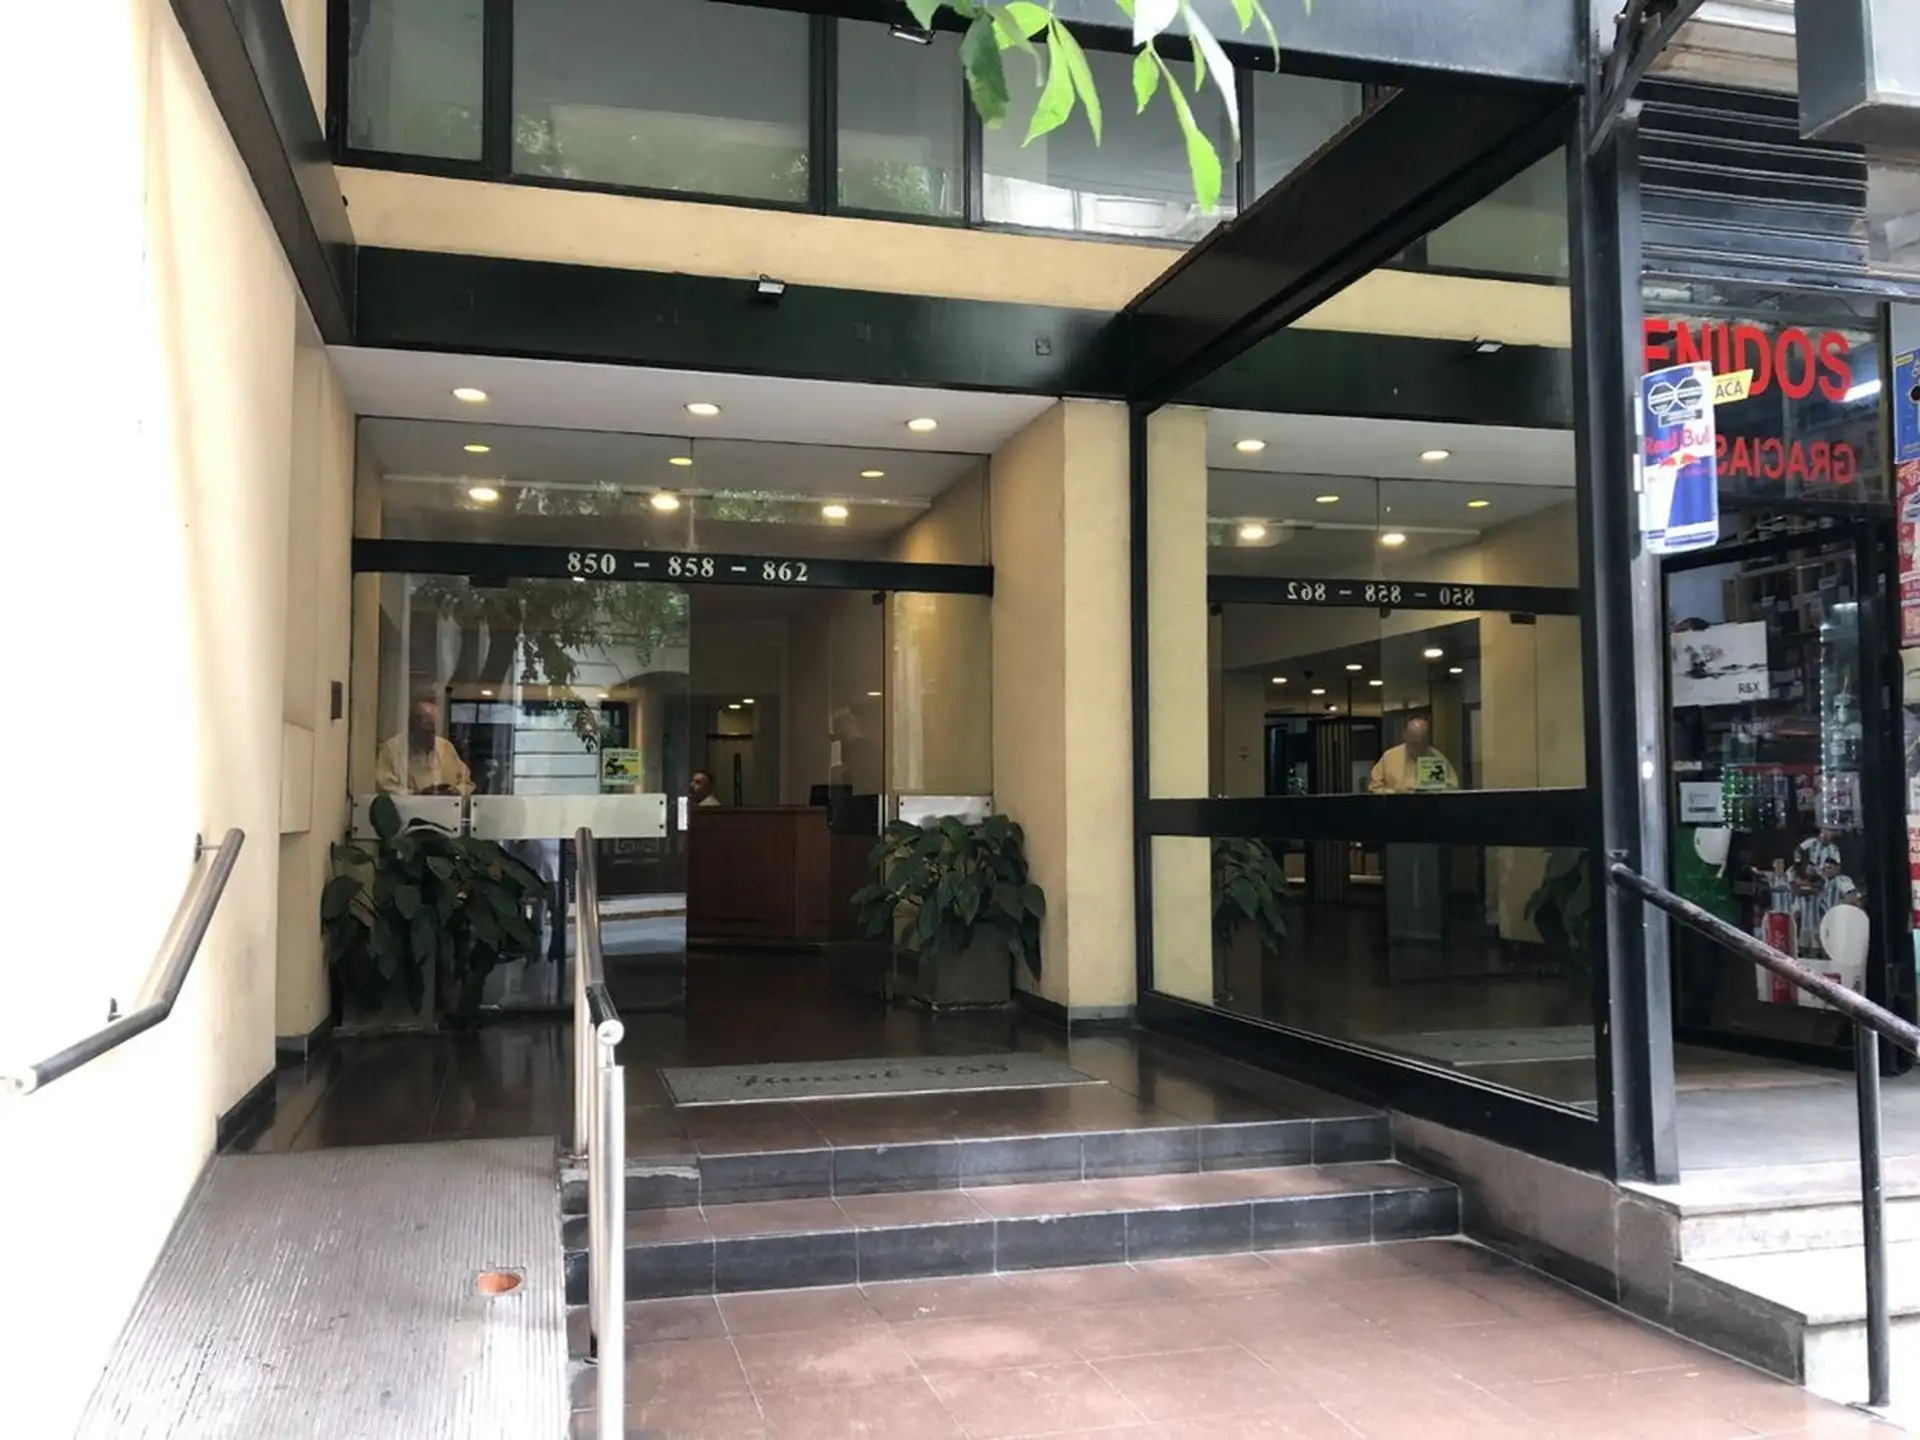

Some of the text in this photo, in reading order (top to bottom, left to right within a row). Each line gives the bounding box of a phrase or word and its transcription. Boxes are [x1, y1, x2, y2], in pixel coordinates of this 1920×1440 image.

[567, 552, 616, 574] 850
[668, 556, 715, 577] 858
[762, 561, 809, 582] 862
